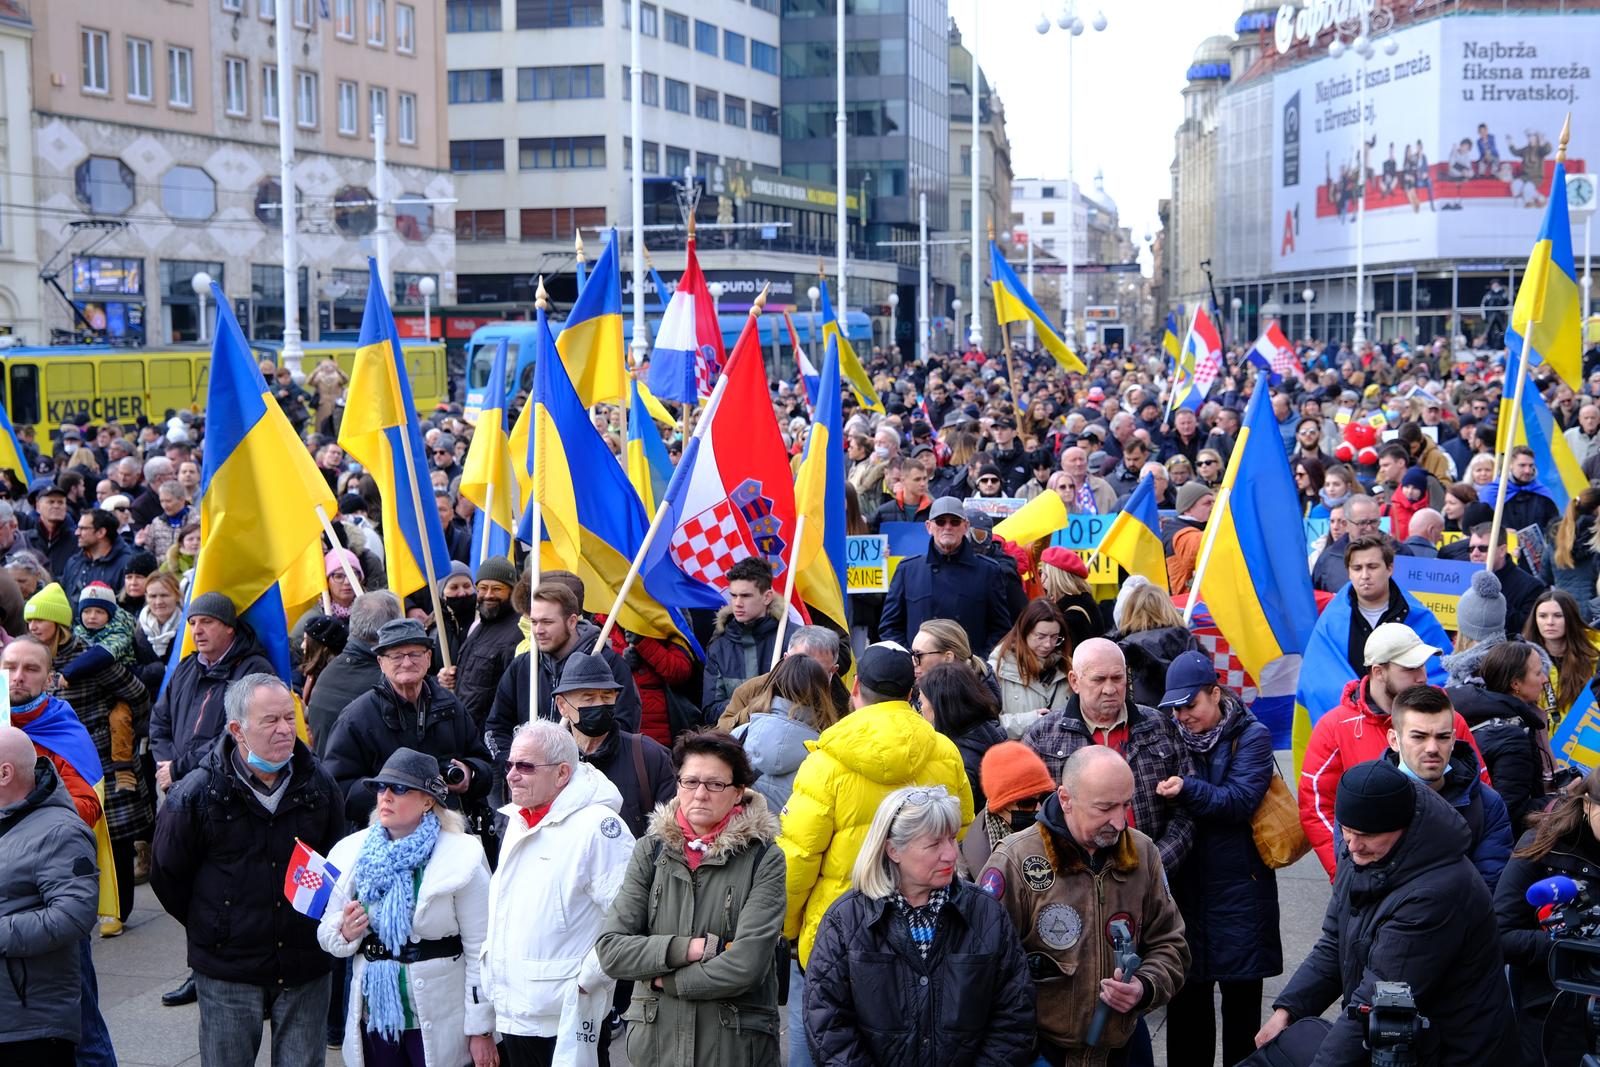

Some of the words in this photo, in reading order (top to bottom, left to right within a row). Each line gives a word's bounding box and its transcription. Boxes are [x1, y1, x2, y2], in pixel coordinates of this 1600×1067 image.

[1463, 41, 1537, 62] Najbrža
[1355, 66, 1391, 93] fksna
[1463, 62, 1523, 80] fiksna
[1530, 62, 1591, 80] mreža
[1462, 88, 1474, 101] u
[1481, 83, 1579, 105] Hrvatskoj.
[1314, 117, 1322, 134] u
[46, 396, 143, 422] KÄRCHER
[1408, 570, 1423, 580] НЕ
